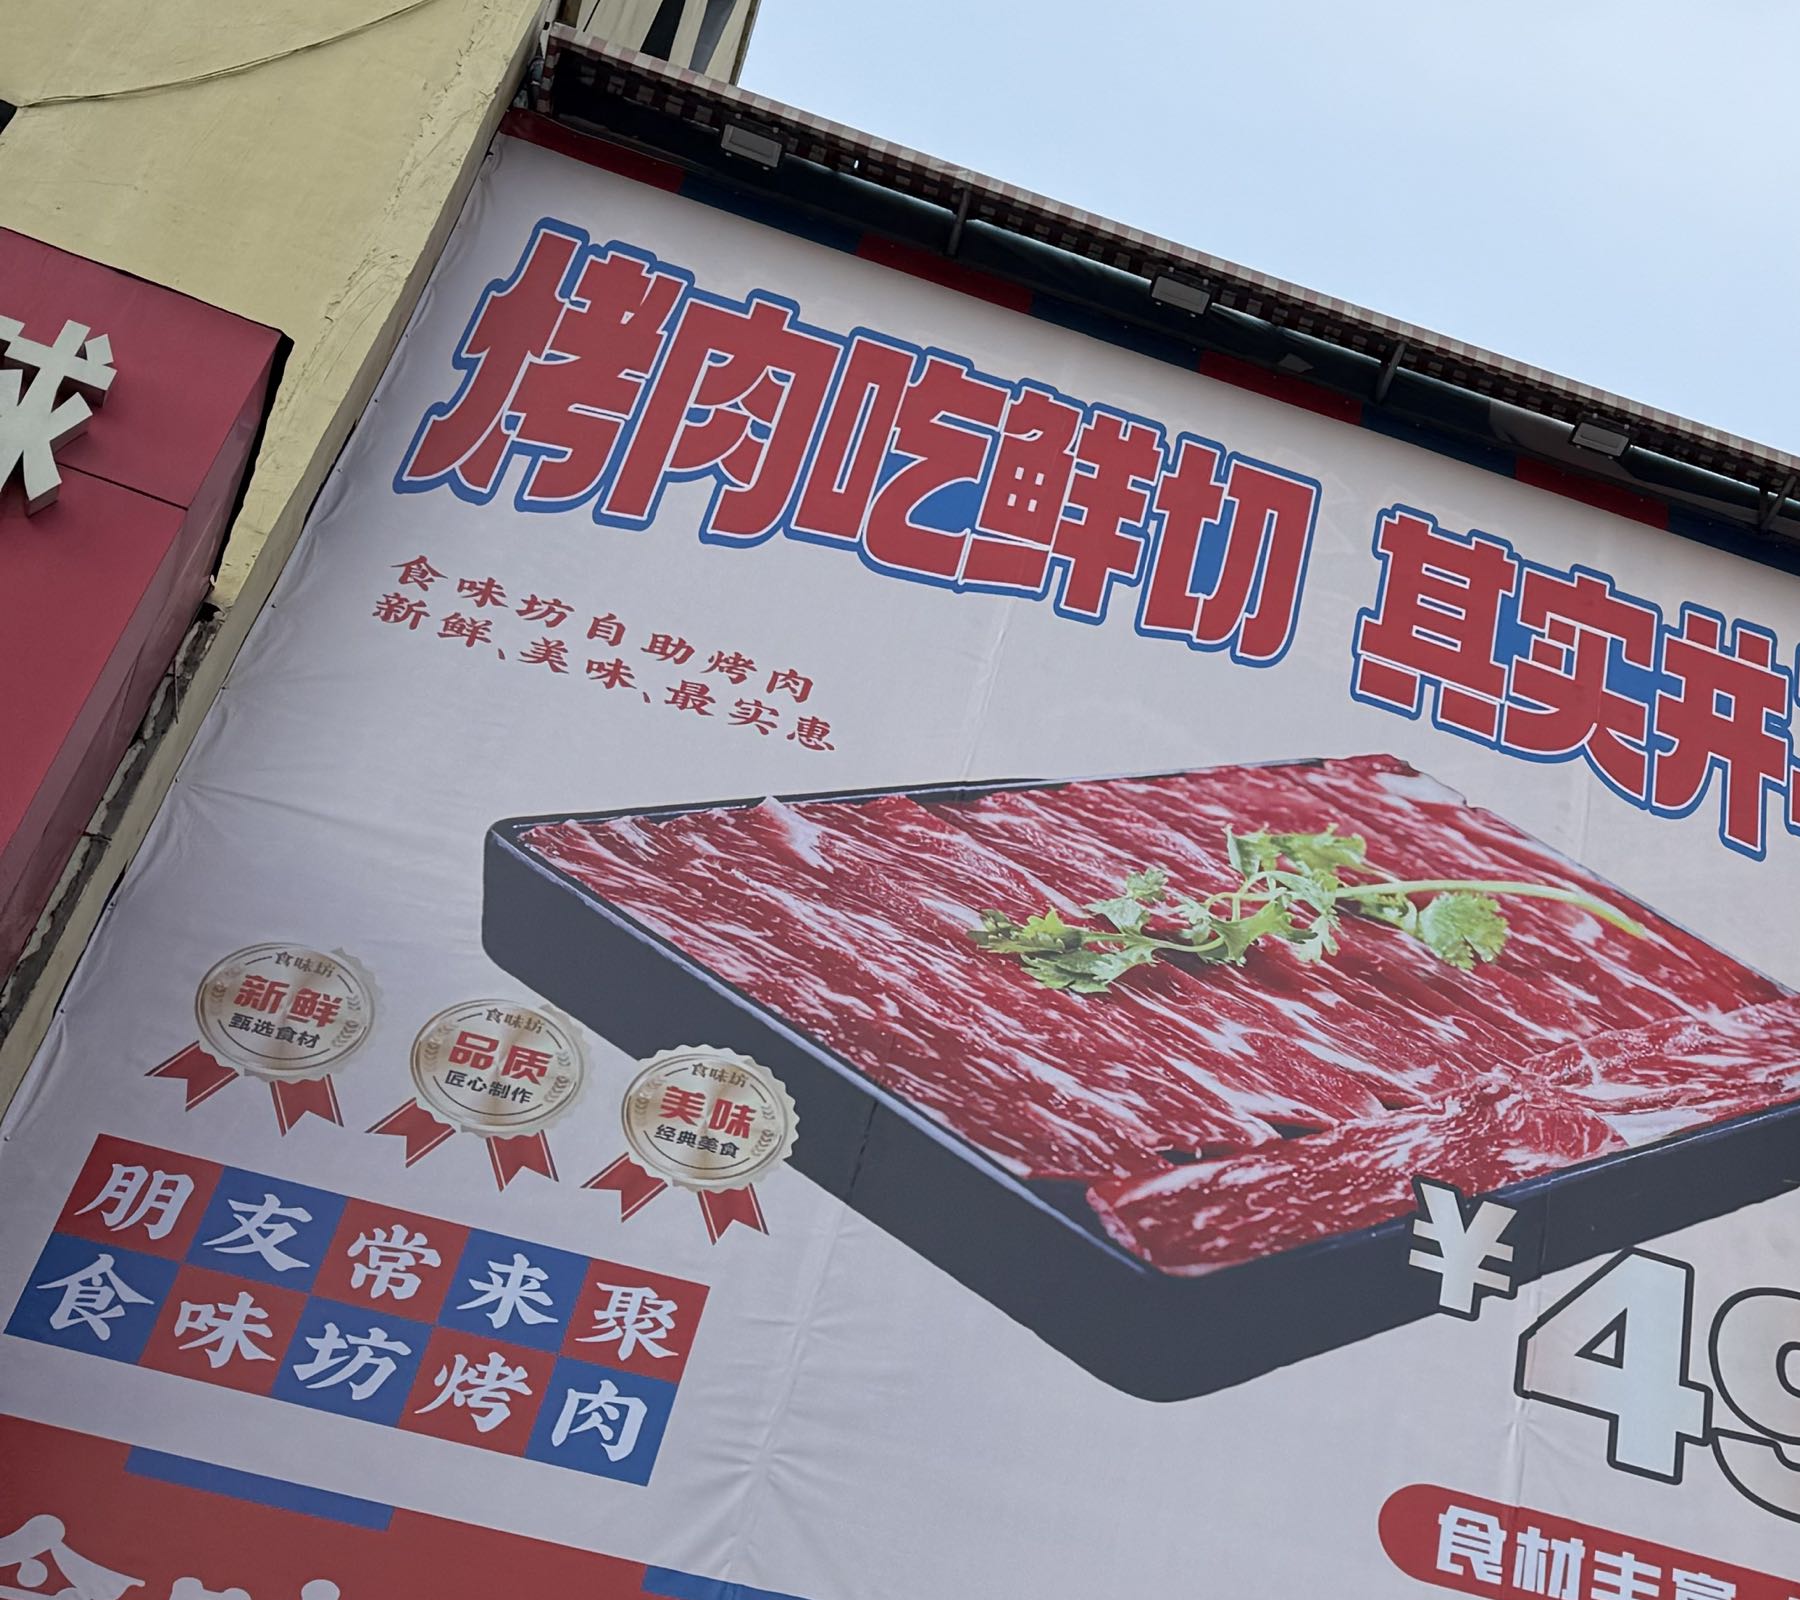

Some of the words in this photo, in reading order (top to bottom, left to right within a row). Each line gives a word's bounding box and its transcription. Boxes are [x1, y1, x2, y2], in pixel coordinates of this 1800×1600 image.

[393, 217, 1321, 666] 烤肉吃鲜切
[391, 555, 814, 703] 食味坊自助烤肉
[372, 592, 836, 752] 新鲜、美味、最实惠
[275, 951, 336, 978] 食味坊
[233, 974, 343, 1028] 新鲜
[485, 1007, 545, 1034] 食味坊
[228, 1012, 320, 1049] 甄选食材
[448, 1031, 554, 1086] 品质
[691, 1062, 750, 1089] 食味坊
[444, 1069, 534, 1105] 匠心制作
[658, 1085, 757, 1139] 美味
[653, 1123, 740, 1159] 经典美食
[74, 1162, 680, 1360] 朋友常来聚
[37, 1252, 650, 1465] 食味坊烤肉
